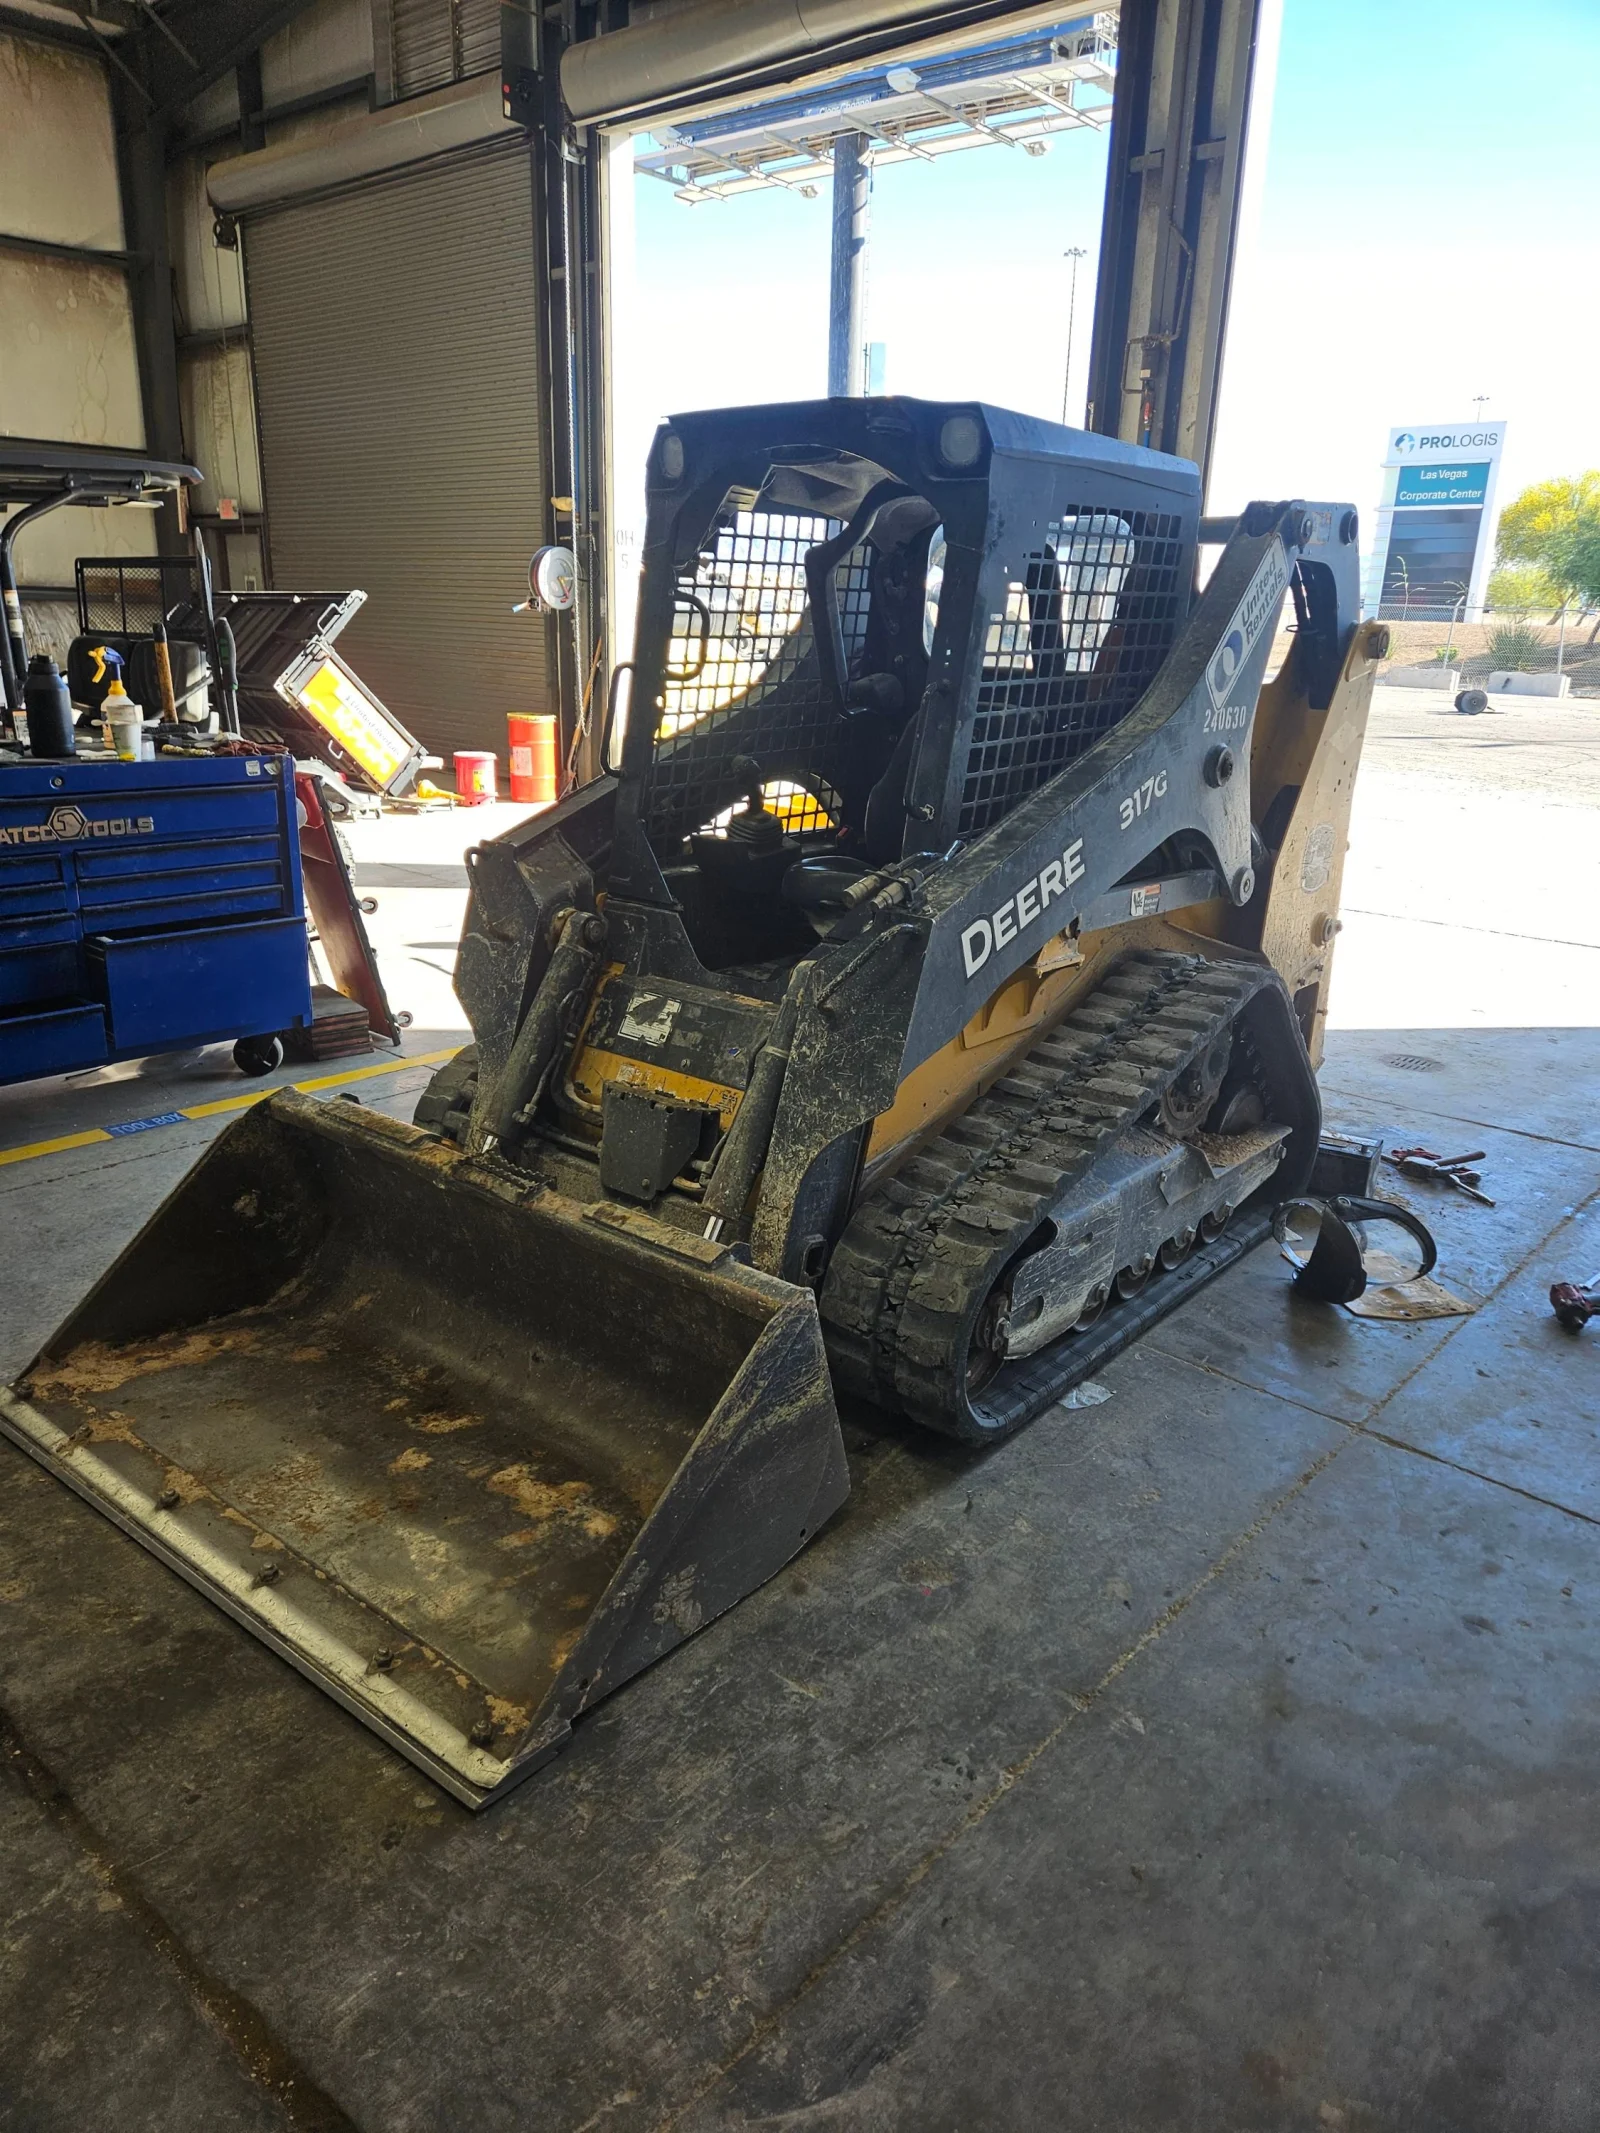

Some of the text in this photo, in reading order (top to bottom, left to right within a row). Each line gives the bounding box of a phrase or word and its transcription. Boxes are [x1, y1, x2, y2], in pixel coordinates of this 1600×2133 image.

[1419, 432, 1498, 449] PROLOGIS
[1420, 469, 1468, 480] Las Vegas
[1400, 489, 1482, 502] Corporate Center
[1241, 552, 1276, 628] United
[1246, 568, 1284, 645] Rentals
[1203, 705, 1247, 733] 240630
[1120, 769, 1168, 830] 317G
[0, 816, 155, 845] ATCO TOOLS
[961, 837, 1086, 979] DEERE
[110, 1112, 186, 1135] TOOL BOX
